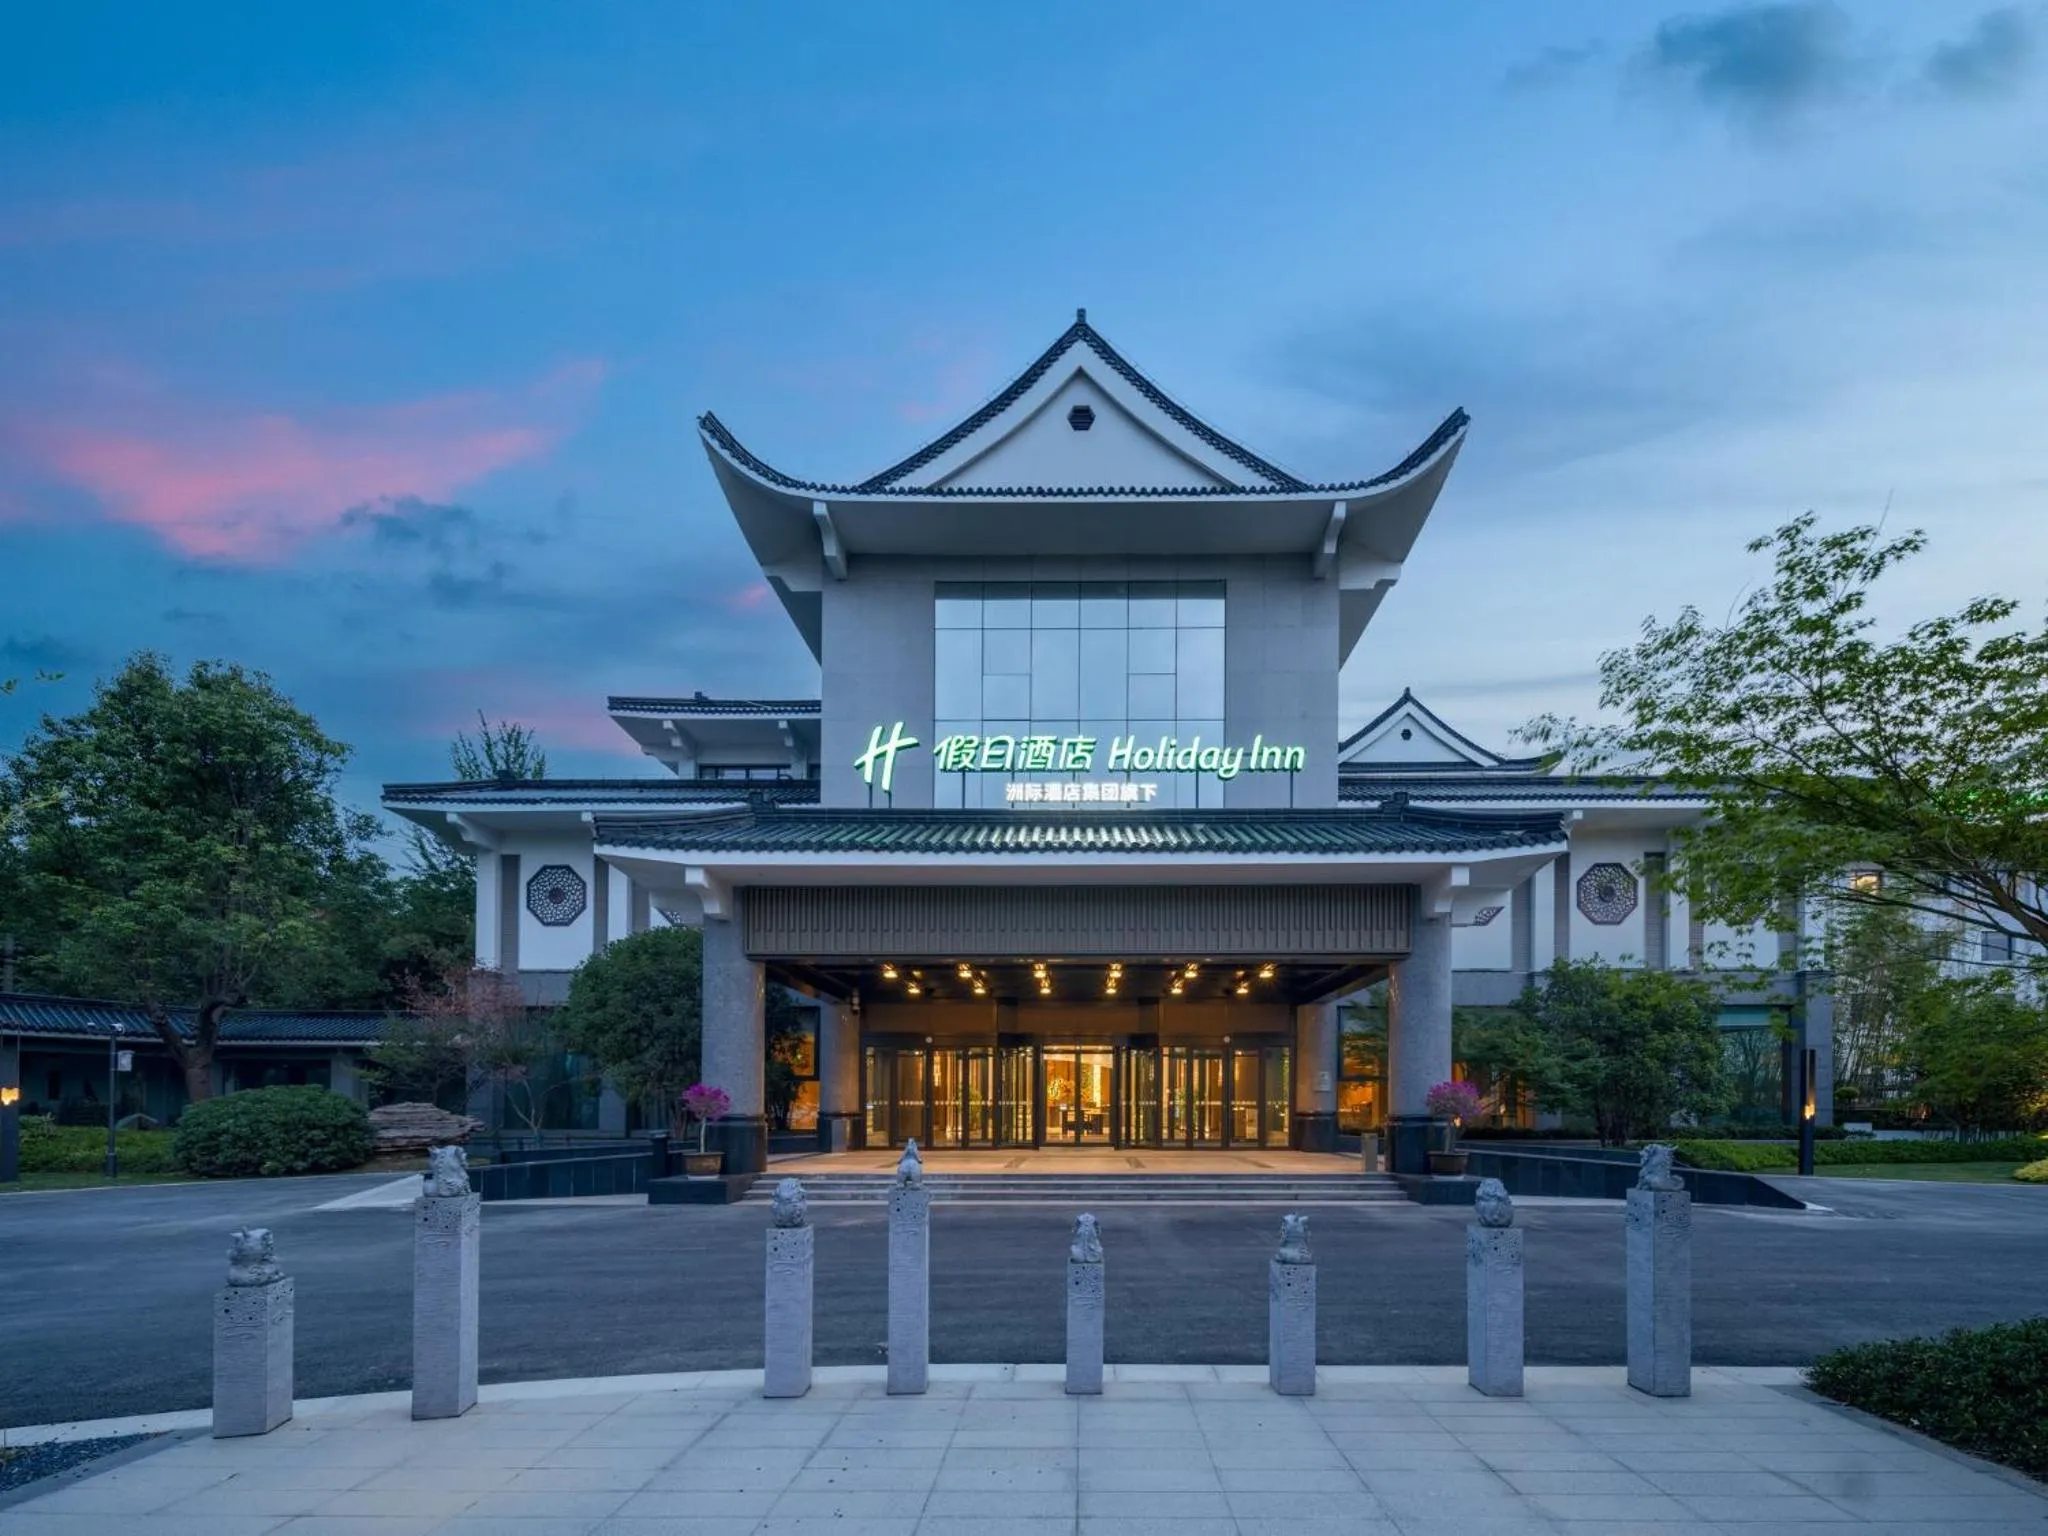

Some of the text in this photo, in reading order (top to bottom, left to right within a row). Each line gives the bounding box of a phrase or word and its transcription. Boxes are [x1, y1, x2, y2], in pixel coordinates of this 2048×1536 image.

[933, 734, 1097, 771] 假日酒店
[1108, 734, 1306, 779] Holiday Inn
[1006, 783, 1158, 802] 洲际酒店集团旗下
